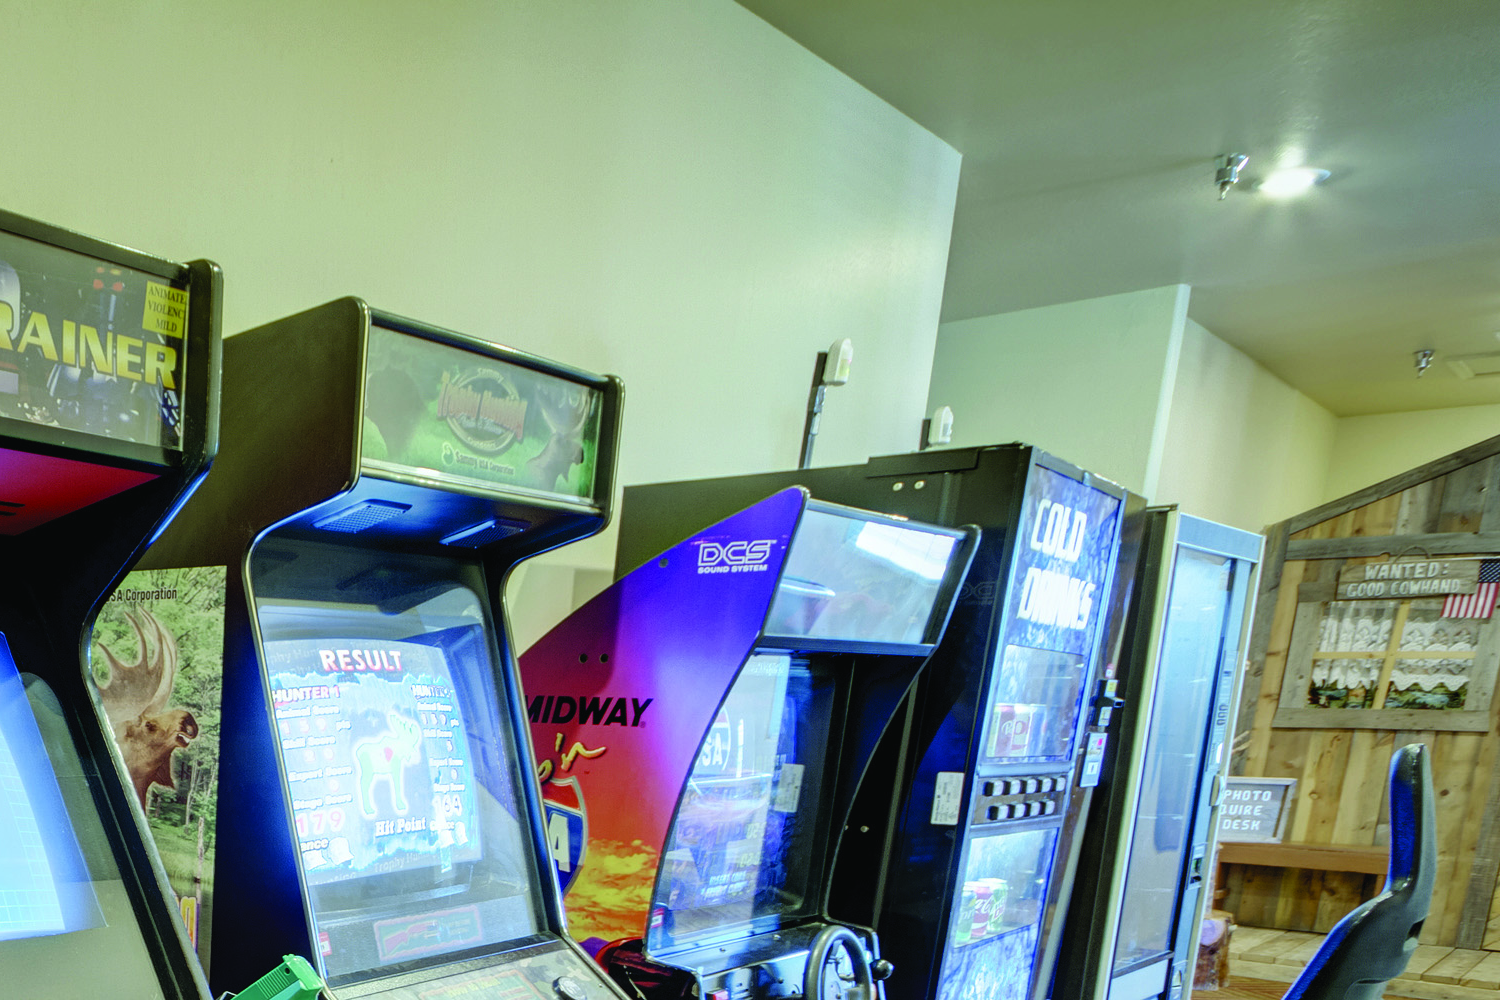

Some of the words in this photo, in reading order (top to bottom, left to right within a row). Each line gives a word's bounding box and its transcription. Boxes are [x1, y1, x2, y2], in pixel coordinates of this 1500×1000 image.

[148, 286, 186, 305] ANIMATE
[148, 300, 184, 320] VIOLENC
[156, 318, 178, 333] MILD
[1030, 498, 1088, 563] COLD
[697, 540, 772, 567] DCS
[697, 565, 730, 575] SOUND
[730, 564, 768, 573] SYSTEM
[1364, 562, 1450, 580] WANTED:
[125, 587, 178, 603] Corporation
[1346, 581, 1385, 598] GOOD
[1390, 579, 1461, 596] COWHAND
[318, 649, 402, 672] RESULT
[271, 685, 330, 703] HUNTER
[333, 685, 341, 699] 1
[524, 694, 654, 728] MIDWAY
[1223, 789, 1272, 801] PHOTO
[1220, 804, 1263, 816] QUIRE
[296, 807, 346, 838] 179
[375, 820, 395, 839] Hit
[396, 816, 427, 835] Point
[1222, 819, 1261, 831] DESK
[300, 838, 329, 853] ance
